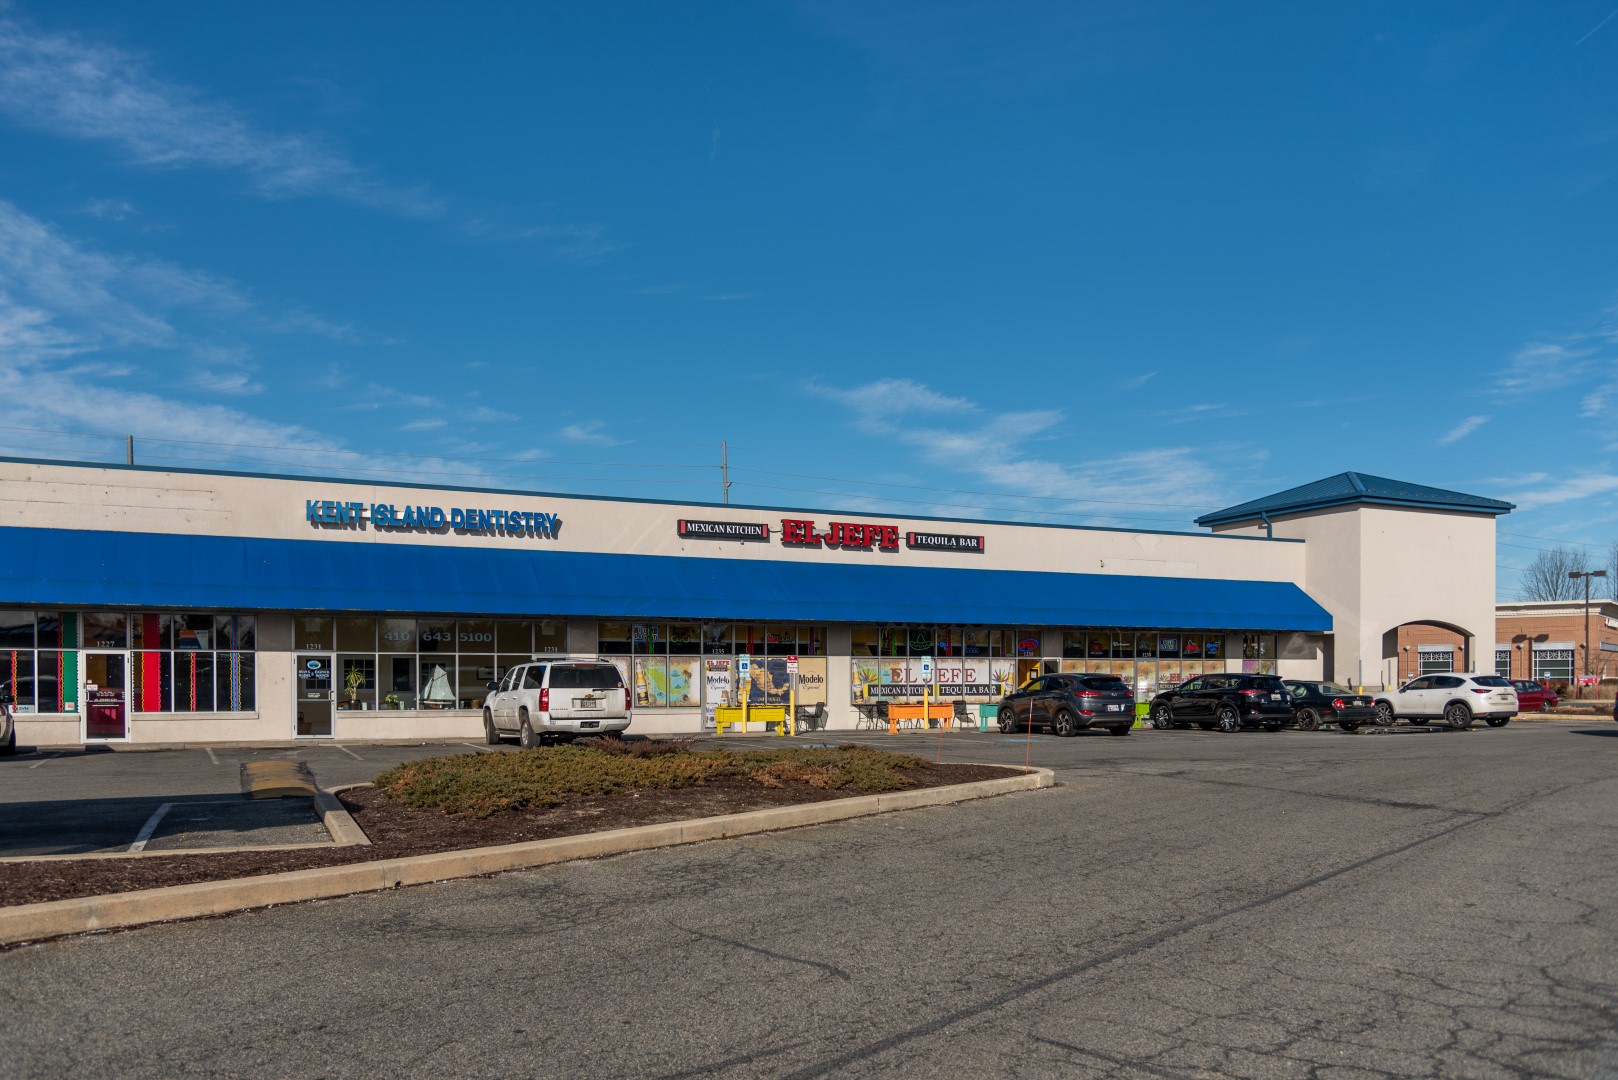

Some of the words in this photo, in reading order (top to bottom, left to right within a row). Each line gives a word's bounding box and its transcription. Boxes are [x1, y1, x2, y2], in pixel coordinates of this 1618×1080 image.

[306, 500, 364, 523] KENT
[370, 503, 445, 528] ISLAND
[450, 508, 558, 533] DENTISTRY
[687, 523, 725, 534] MEXICAN
[726, 525, 762, 535] KITCHEN
[781, 519, 820, 543] EL
[825, 522, 899, 547] JEFE
[916, 535, 956, 546] TEQUILA
[959, 538, 977, 547] BAR
[384, 632, 410, 641] 410
[422, 632, 452, 641] 643
[460, 633, 492, 642] 5100
[1018, 640, 1036, 649] OPEN
[707, 676, 730, 685] Modelo
[798, 674, 824, 685] Modelo
[890, 668, 917, 683] EL
[923, 668, 977, 683] JEFE
[902, 686, 932, 695] KITCHN
[941, 686, 977, 695] TEQUILA
[979, 686, 997, 694] BAR
